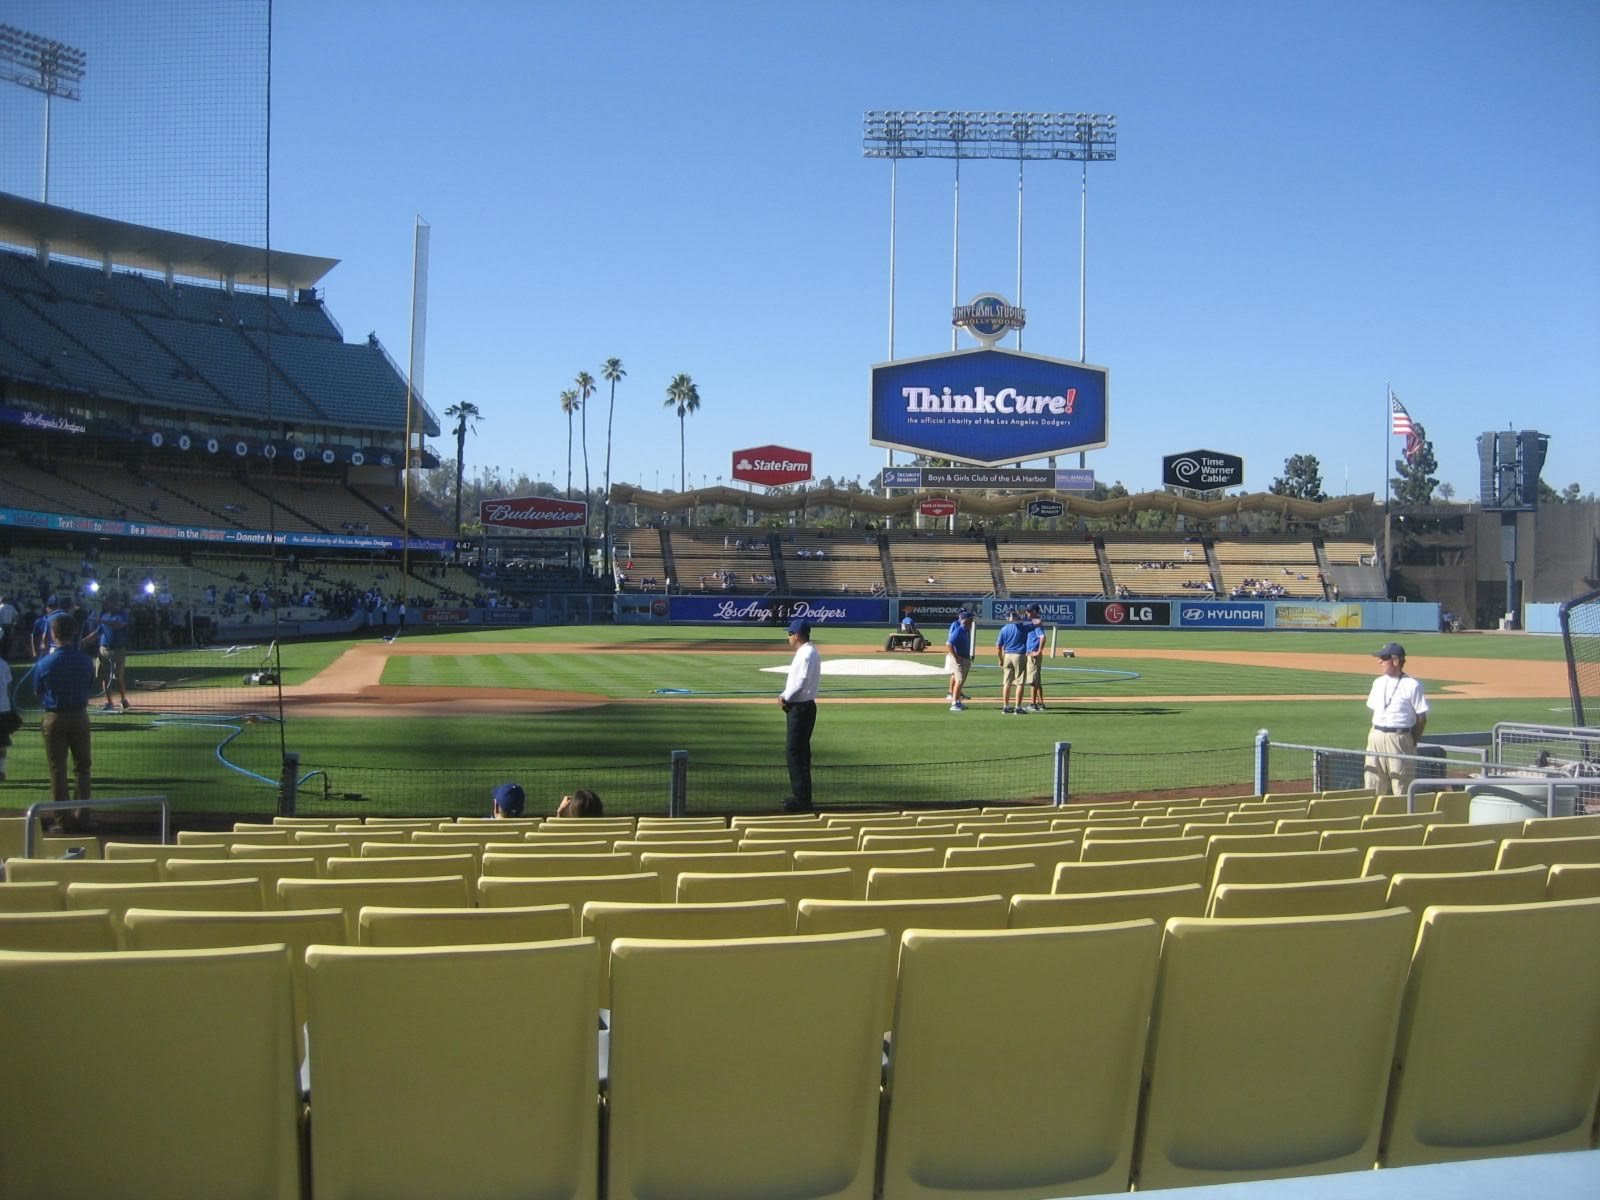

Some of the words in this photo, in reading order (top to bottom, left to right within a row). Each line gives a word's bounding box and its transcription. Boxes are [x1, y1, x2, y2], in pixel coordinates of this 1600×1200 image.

[953, 304, 993, 320] UNIVERSAL
[996, 304, 1027, 320] STUDIOS
[901, 386, 1077, 415] ThinkCure!
[58, 418, 86, 433] Dodgers
[948, 417, 972, 426] charity
[984, 417, 995, 425] the
[1010, 418, 1039, 427] Angeles
[1041, 418, 1071, 427] Dodgers
[1201, 457, 1225, 466] Time
[1201, 466, 1235, 474] Warner
[928, 474, 945, 483] Boys
[946, 474, 952, 482] &
[953, 474, 970, 482] Girls
[971, 474, 989, 482] Club
[989, 474, 997, 482] of
[1201, 474, 1227, 482] Cable
[485, 504, 584, 521] Budweiser
[58, 517, 73, 529] Text
[94, 521, 102, 531] to
[130, 524, 140, 534] Be
[177, 528, 185, 538] in
[186, 528, 200, 539] the
[316, 537, 332, 545] charity
[354, 539, 373, 547] Angeles
[373, 539, 393, 548] Dodgers
[713, 600, 737, 620] Los
[790, 601, 847, 623] Dodgers
[1129, 606, 1153, 621] LG
[1207, 610, 1264, 620] HYUNDAI
